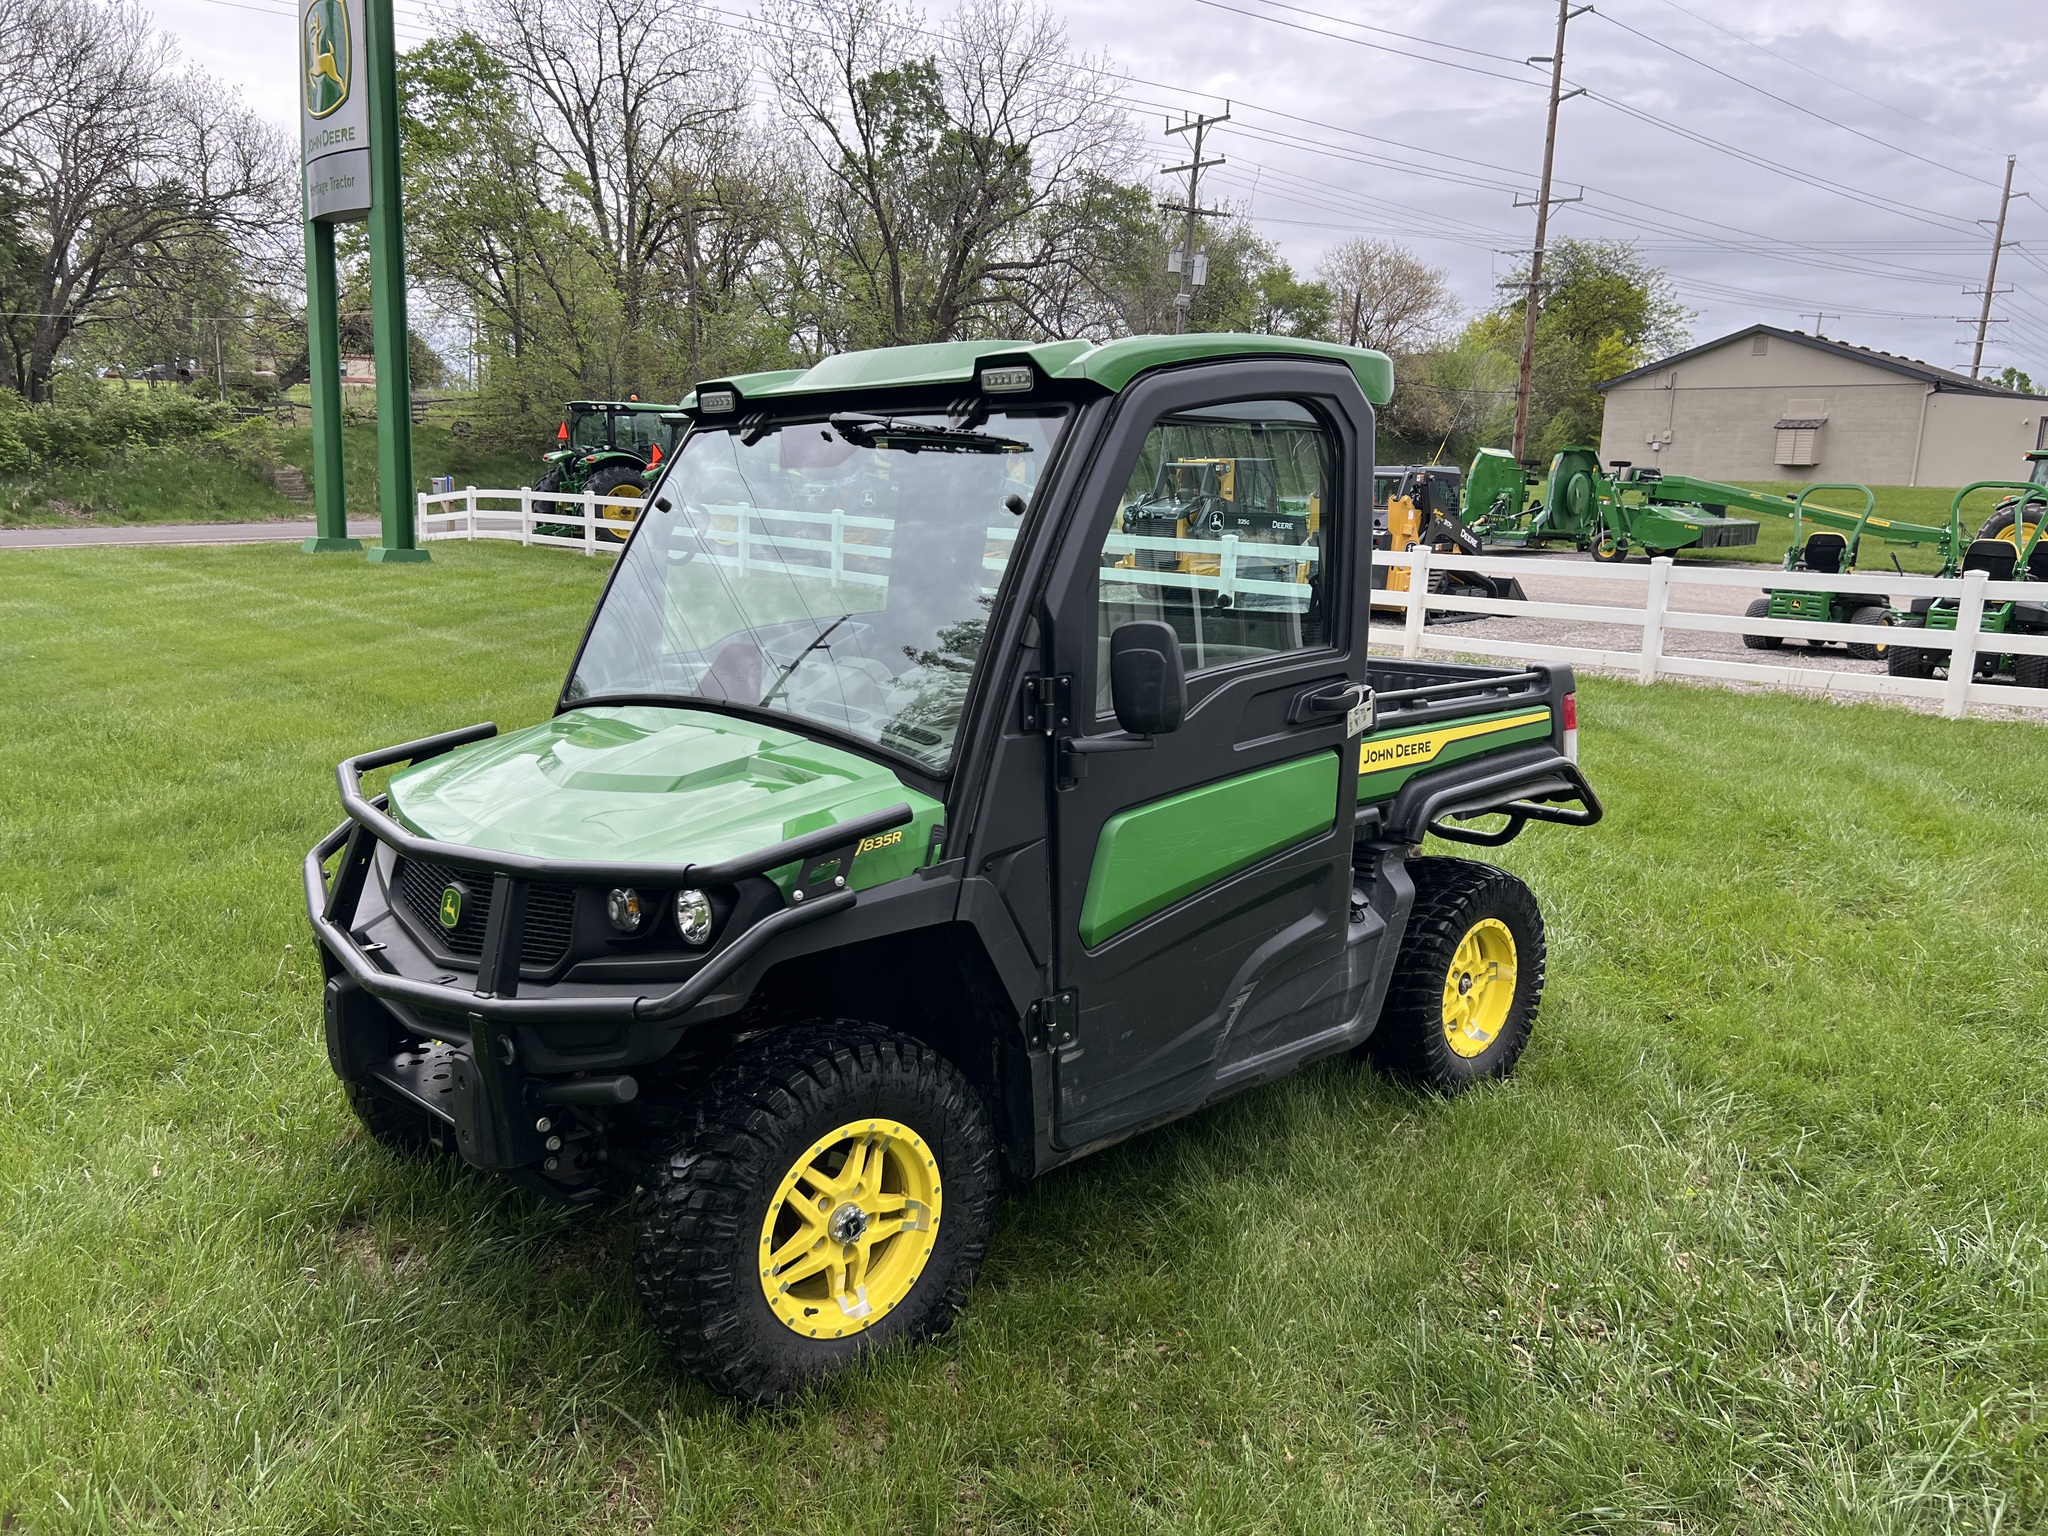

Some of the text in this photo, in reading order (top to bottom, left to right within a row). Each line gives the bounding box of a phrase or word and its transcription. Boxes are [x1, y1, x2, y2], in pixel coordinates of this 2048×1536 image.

[322, 126, 355, 147] DEERE
[329, 174, 355, 191] Tractor
[1272, 520, 1294, 530] DEERE
[1460, 528, 1478, 548] DEERE
[1363, 740, 1431, 764] JOHN DEERE
